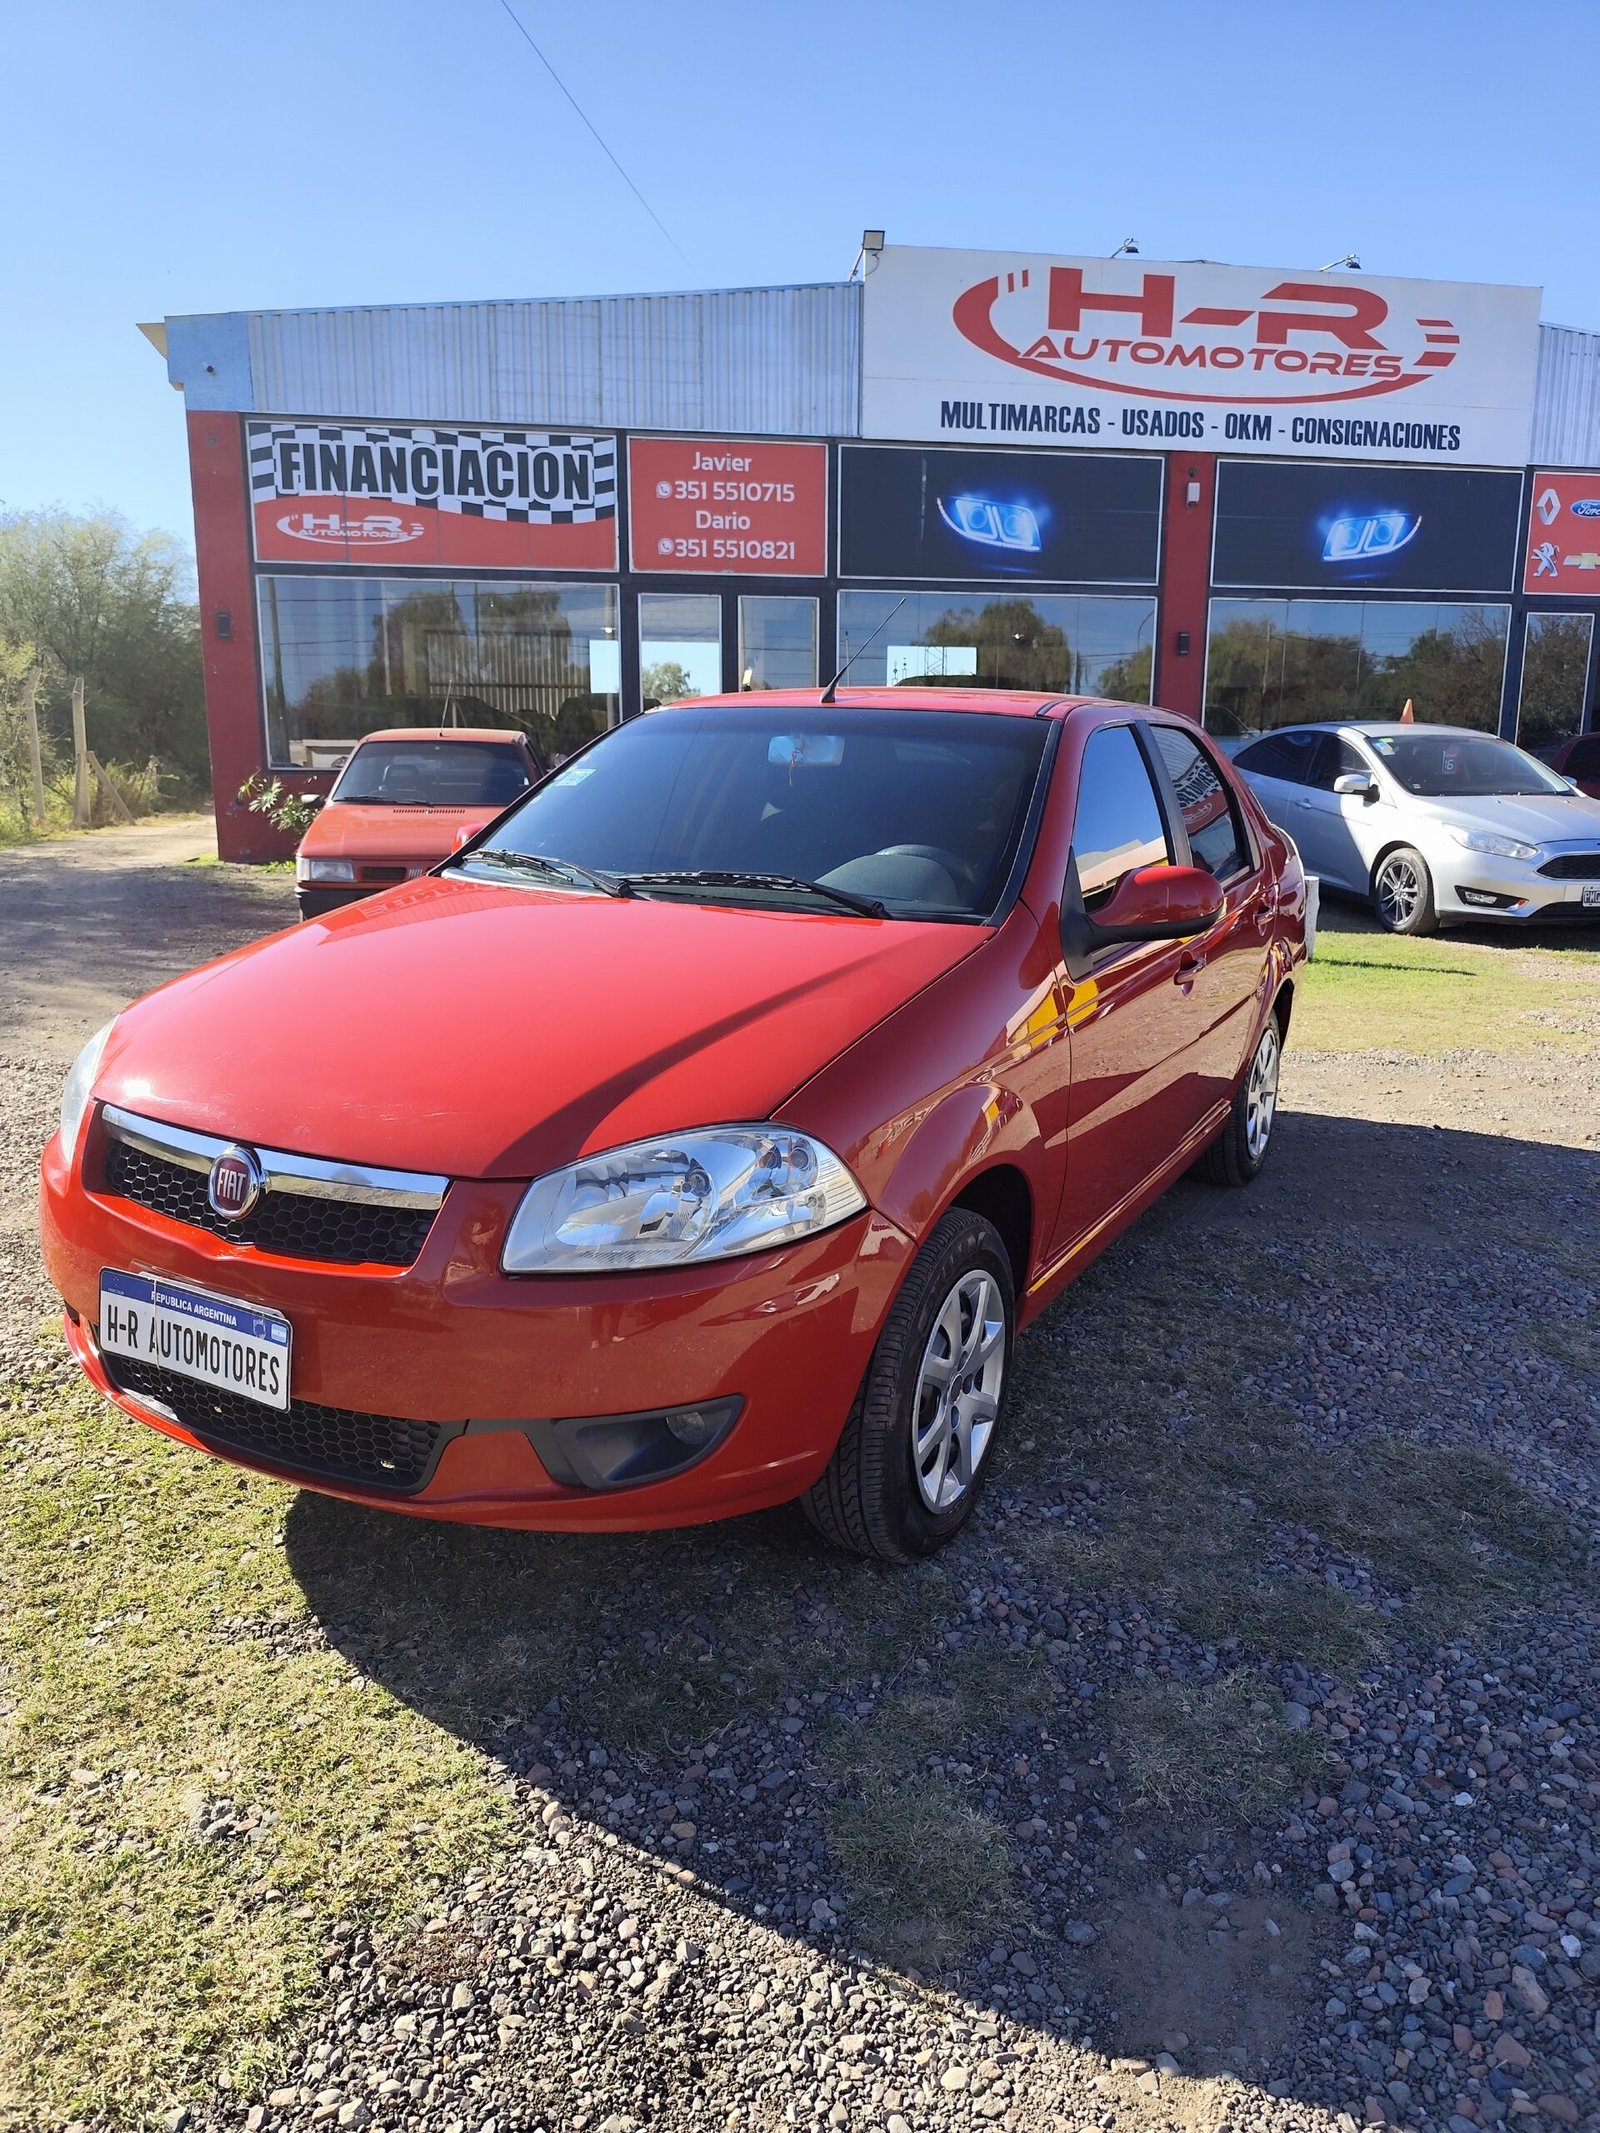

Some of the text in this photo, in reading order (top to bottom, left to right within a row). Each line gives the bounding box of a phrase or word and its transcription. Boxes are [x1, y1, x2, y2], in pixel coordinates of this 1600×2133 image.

[1048, 266, 1388, 350] H-R
[1020, 335, 1403, 378] AUTOMOTORES
[941, 400, 1100, 434] MULTIMARCAS
[1122, 408, 1204, 438] USADOS
[1291, 416, 1460, 450] CONSIGNACIONES
[278, 442, 589, 501] FINANCIACION
[692, 452, 752, 472] Javier
[674, 480, 795, 502] 351 5510715
[297, 529, 409, 539] AUTOMOTORES
[302, 513, 403, 531] H-R
[695, 510, 750, 530] Dario
[674, 539, 796, 560] 351 5510821
[217, 1167, 247, 1202] FIAT
[150, 1290, 237, 1327] REPUBLICA ARGENTINA
[107, 1304, 280, 1395] H-R AUTOMOTORES
